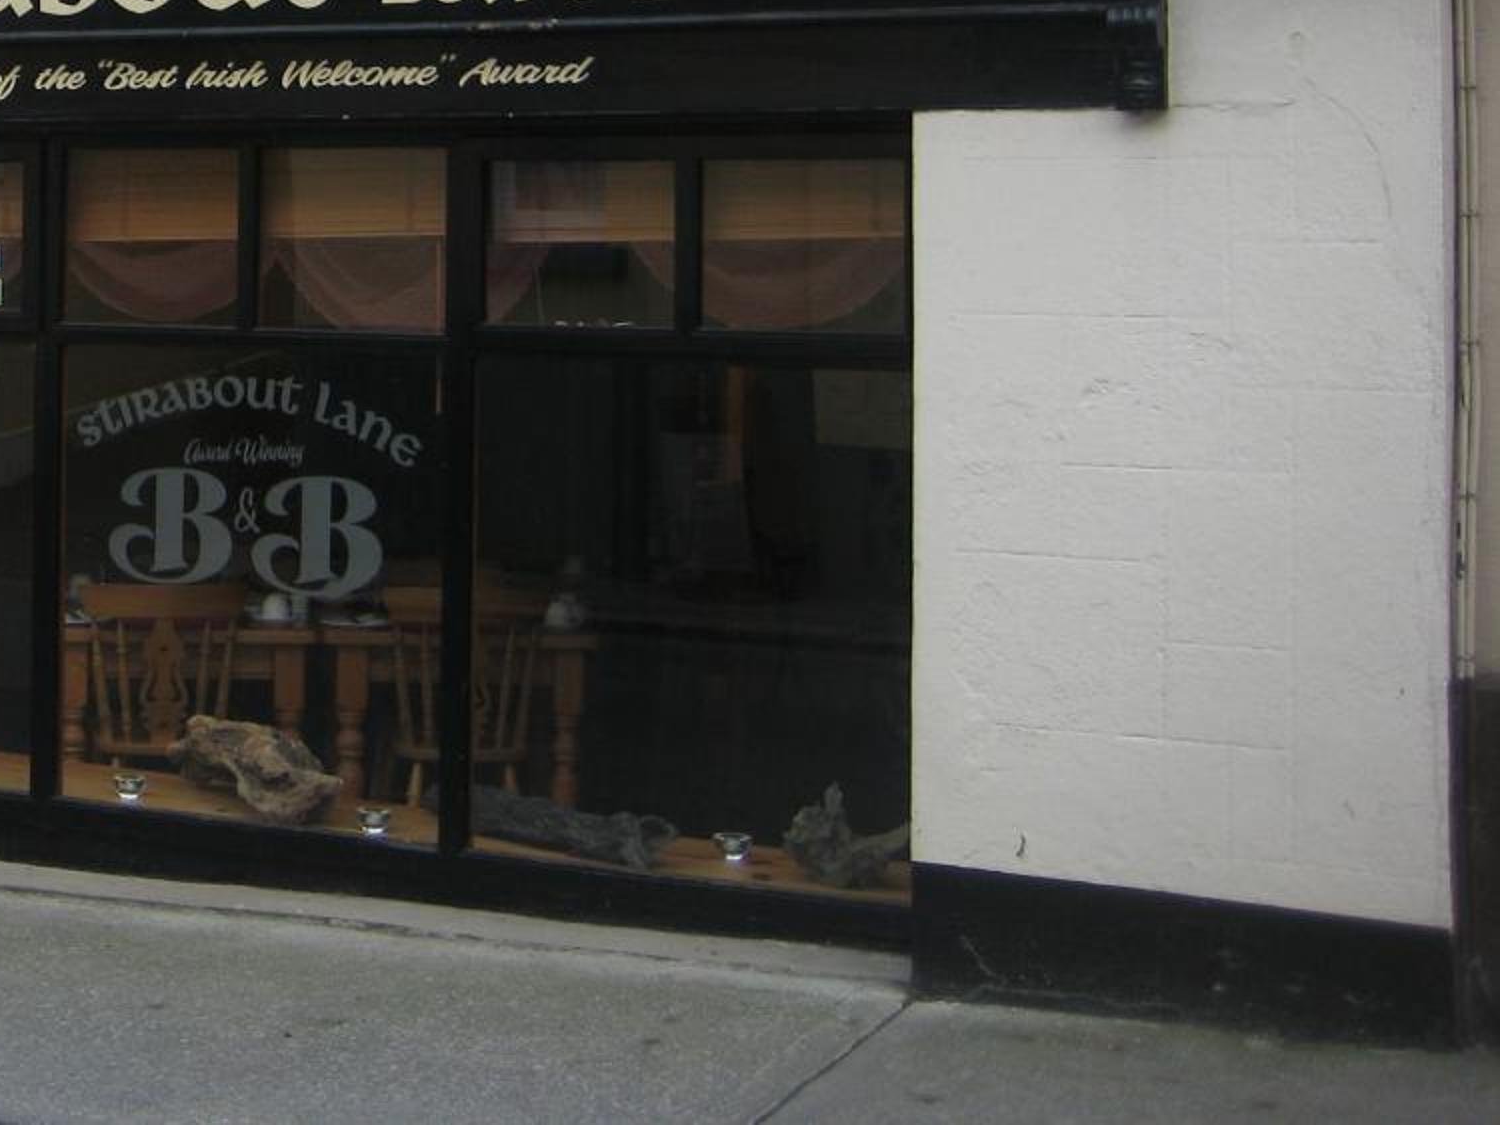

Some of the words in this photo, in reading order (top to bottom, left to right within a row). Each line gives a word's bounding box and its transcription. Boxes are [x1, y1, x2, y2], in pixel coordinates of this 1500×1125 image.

[35, 63, 86, 92] the
[96, 59, 179, 92] "Best
[185, 59, 266, 90] Irish
[457, 56, 595, 88] Award
[183, 436, 230, 464] Award
[234, 434, 304, 464] Winning
[109, 467, 232, 584] B
[234, 487, 260, 533] &
[250, 476, 384, 602] B
